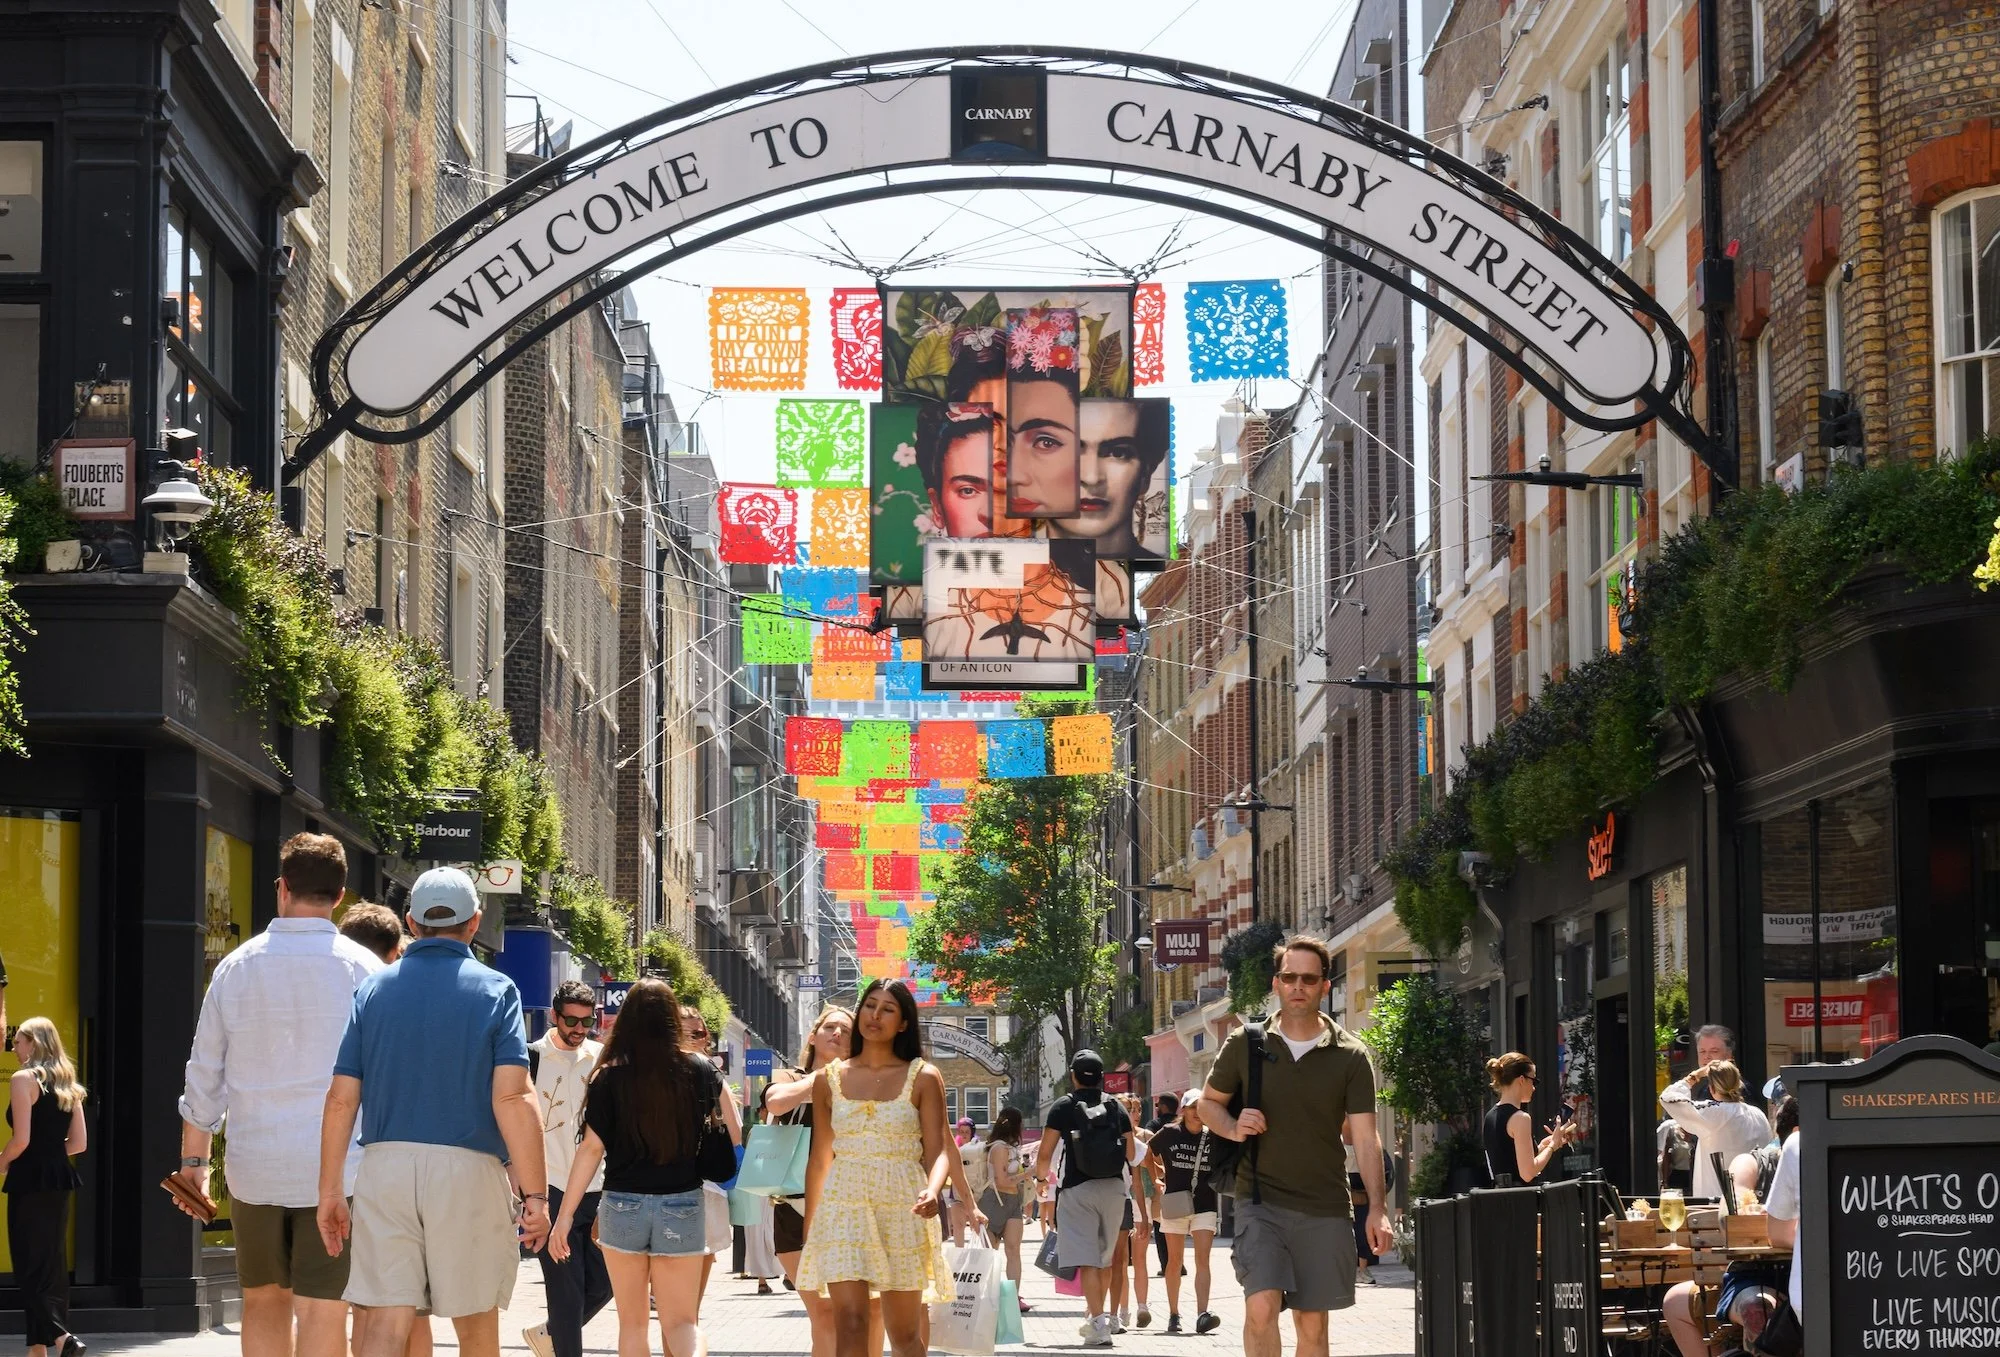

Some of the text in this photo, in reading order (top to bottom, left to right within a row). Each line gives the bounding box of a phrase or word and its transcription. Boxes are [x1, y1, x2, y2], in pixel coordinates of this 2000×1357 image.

[965, 107, 1033, 120] CARNABY
[429, 101, 1609, 353] WELCOME TO CARNABY STREET
[737, 325, 792, 341] PAINT
[719, 342, 800, 358] MY OWN
[722, 357, 797, 373] REALITY
[64, 462, 124, 483] FOUBERT'S
[68, 487, 106, 507] PLACE
[935, 549, 1005, 577] TATE
[959, 663, 978, 673] AN
[981, 663, 1013, 673] ICON
[415, 823, 472, 838] Barbour
[1166, 933, 1200, 949] MUJI
[932, 1030, 1001, 1068] CARNABY STREET
[1842, 1092, 1970, 1107] SHAKESPEARES
[1841, 1173, 1963, 1214] WHAT'S
[1877, 1213, 1995, 1228] @ SHAKESPEARES HEAD
[1846, 1250, 1883, 1280] BIG
[1897, 1249, 1948, 1278] LIVE
[1872, 1298, 1924, 1326] LIVE
[1863, 1328, 1921, 1350] EVERY
